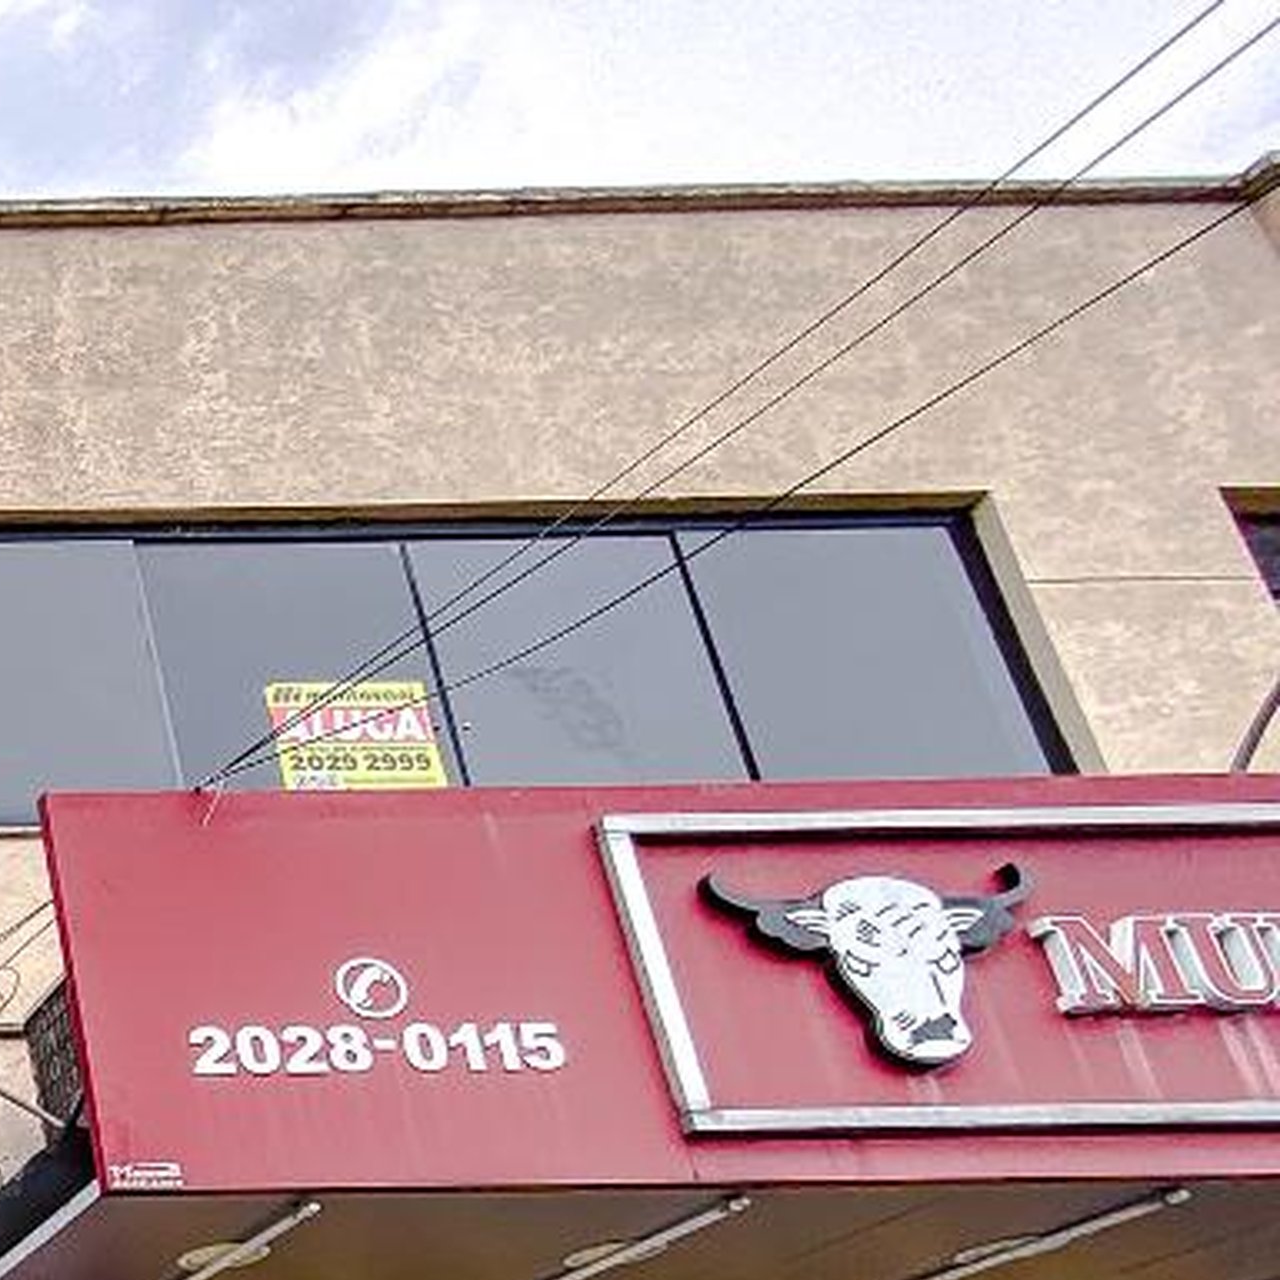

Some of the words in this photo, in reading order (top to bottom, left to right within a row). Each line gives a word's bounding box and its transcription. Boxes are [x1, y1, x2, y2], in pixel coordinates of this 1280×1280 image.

[290, 754, 357, 771] 2029
[364, 753, 431, 771] 2999
[189, 1022, 566, 1075] 2028-0115
